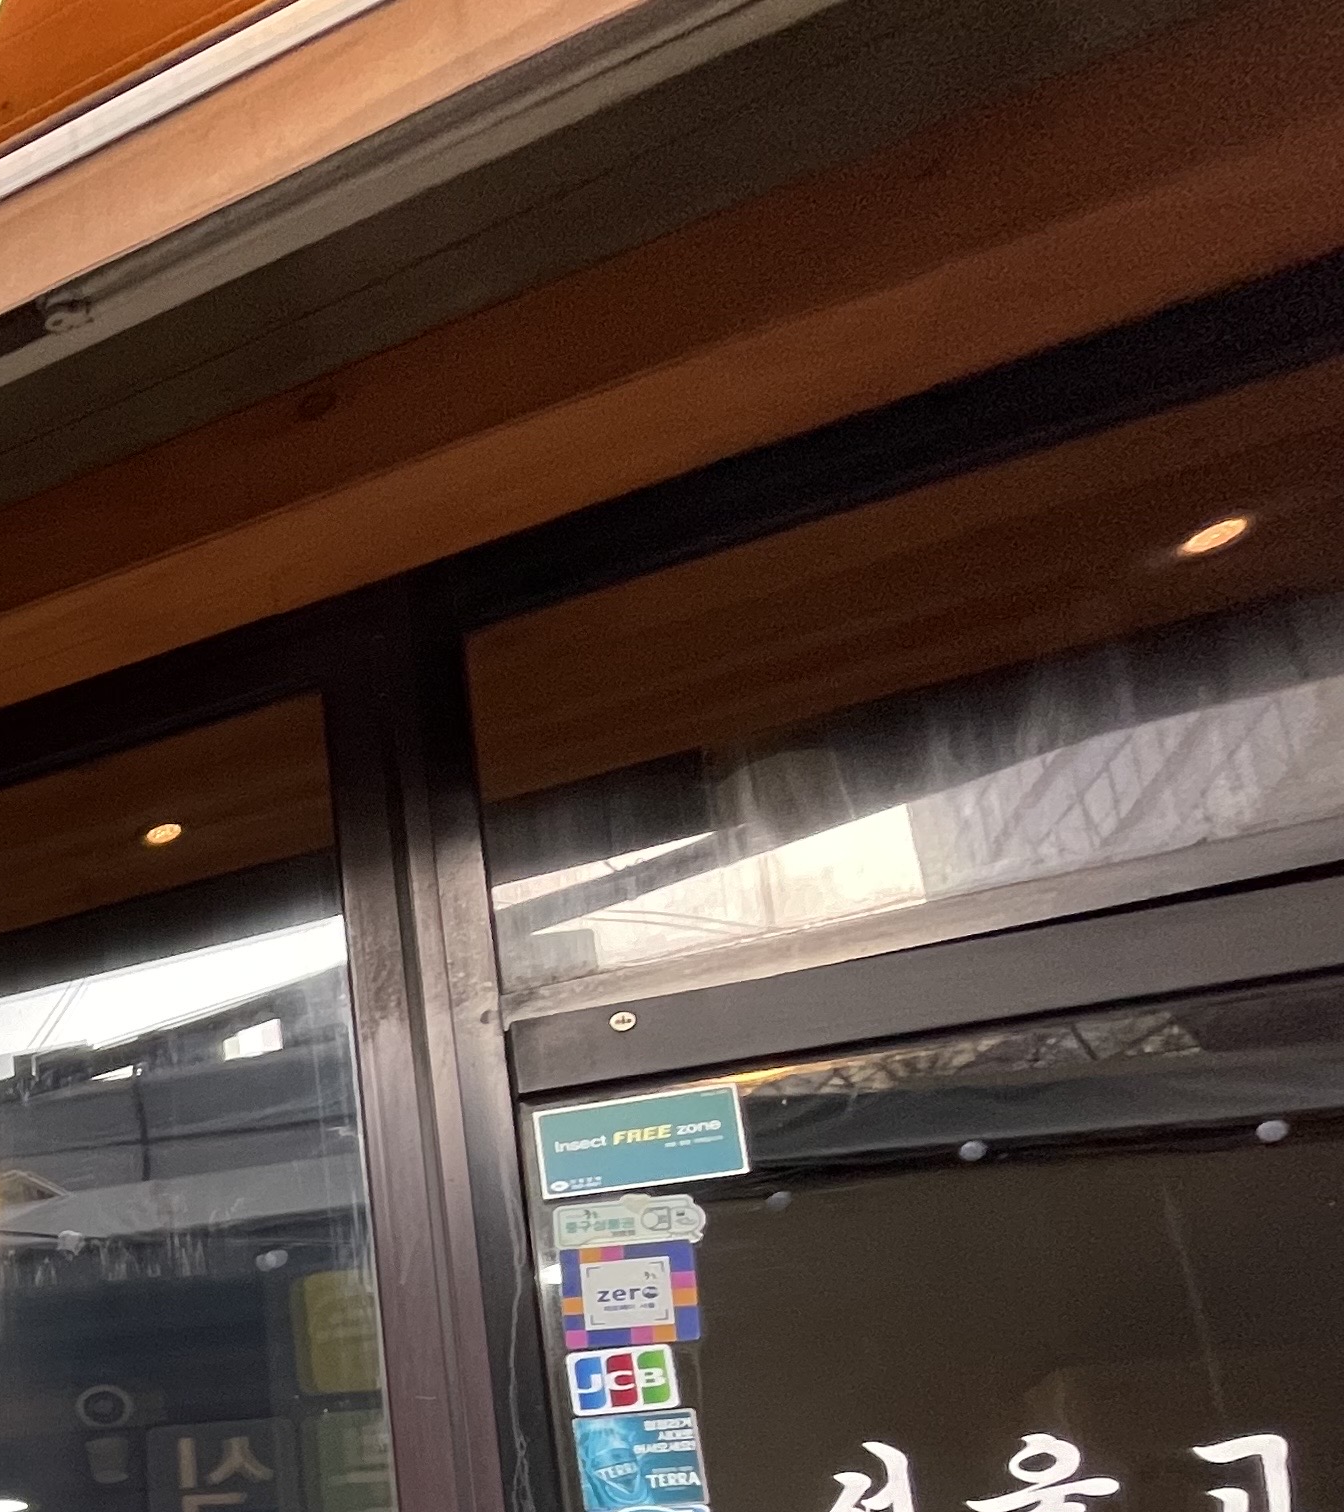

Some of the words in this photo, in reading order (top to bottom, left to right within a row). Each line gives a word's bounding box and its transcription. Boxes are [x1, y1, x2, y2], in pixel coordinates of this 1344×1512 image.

[554, 1133, 607, 1154] Insect
[612, 1123, 673, 1146] FREE
[675, 1118, 723, 1137] zone
[596, 1286, 660, 1304] zero
[644, 1471, 702, 1489] TERRA
